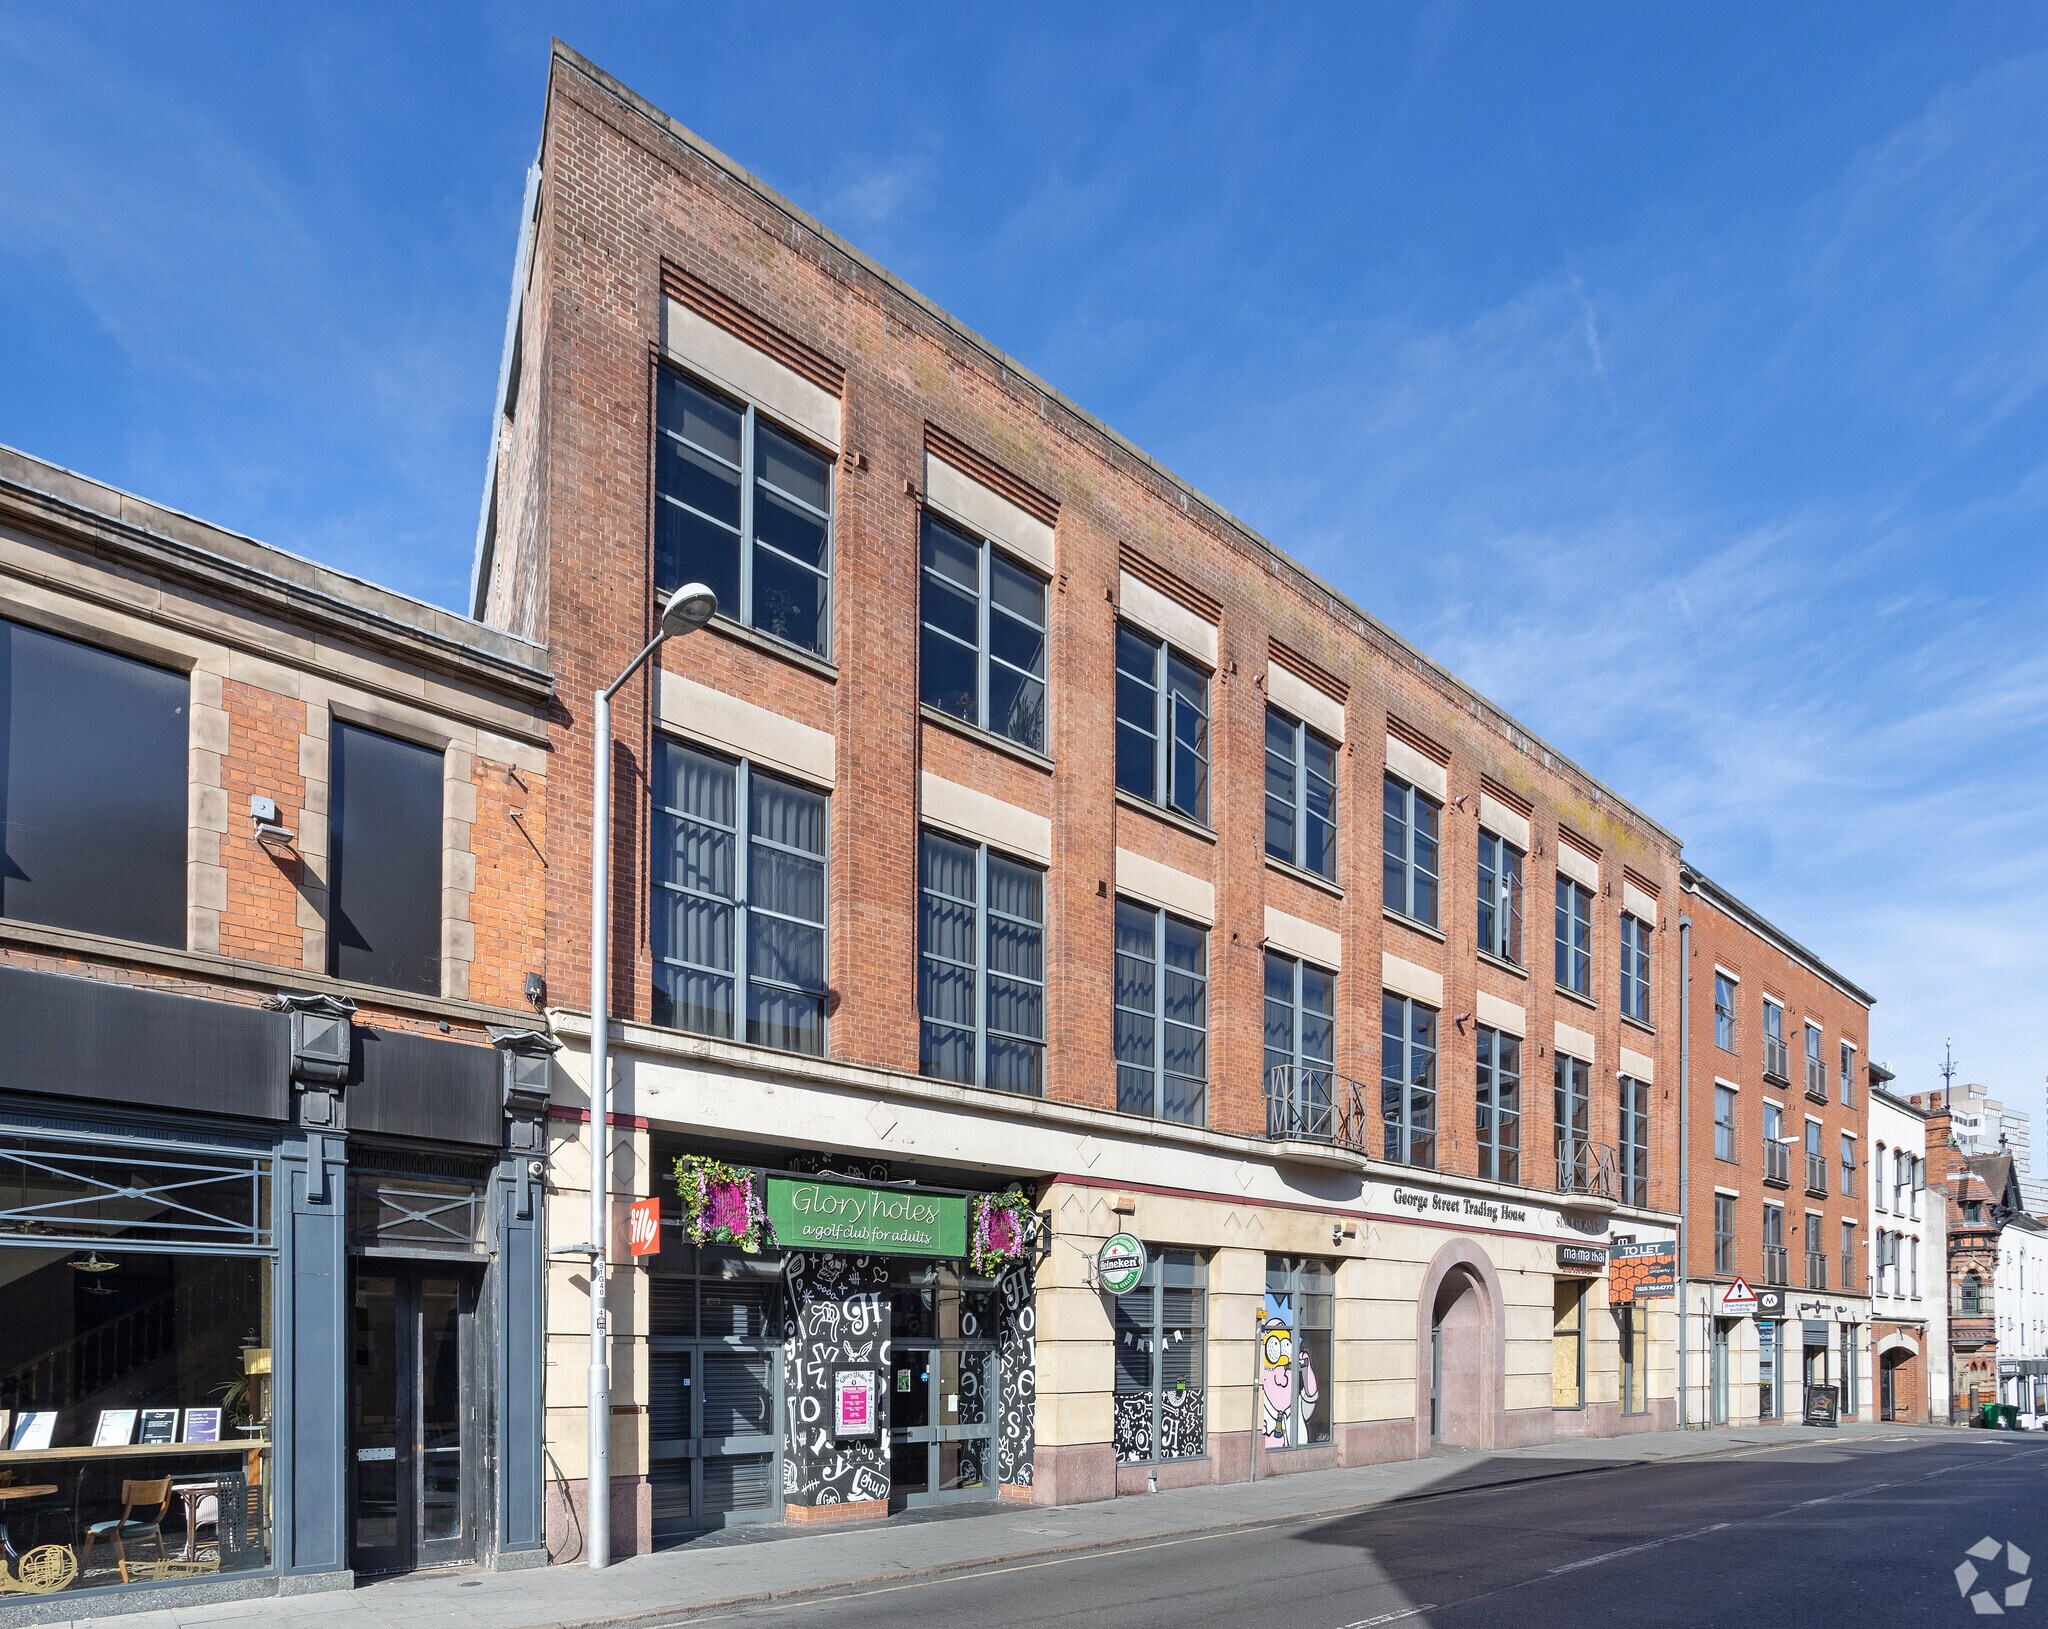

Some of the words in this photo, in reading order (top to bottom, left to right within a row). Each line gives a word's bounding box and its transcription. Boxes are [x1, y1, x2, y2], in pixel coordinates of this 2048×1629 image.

[792, 1185, 867, 1223] Glory
[872, 1191, 940, 1225] holes
[1393, 1187, 1429, 1213] George
[1432, 1193, 1460, 1214] Street
[1463, 1198, 1499, 1223] Trading
[1501, 1204, 1527, 1223] House
[871, 1227, 890, 1243] for
[891, 1229, 932, 1245] adults
[1591, 1251, 1605, 1263] thai
[1623, 1246, 1638, 1256] TO
[1639, 1245, 1661, 1255] LET
[1100, 1256, 1137, 1271] Heineken
[1724, 1301, 1756, 1309] Overhanging
